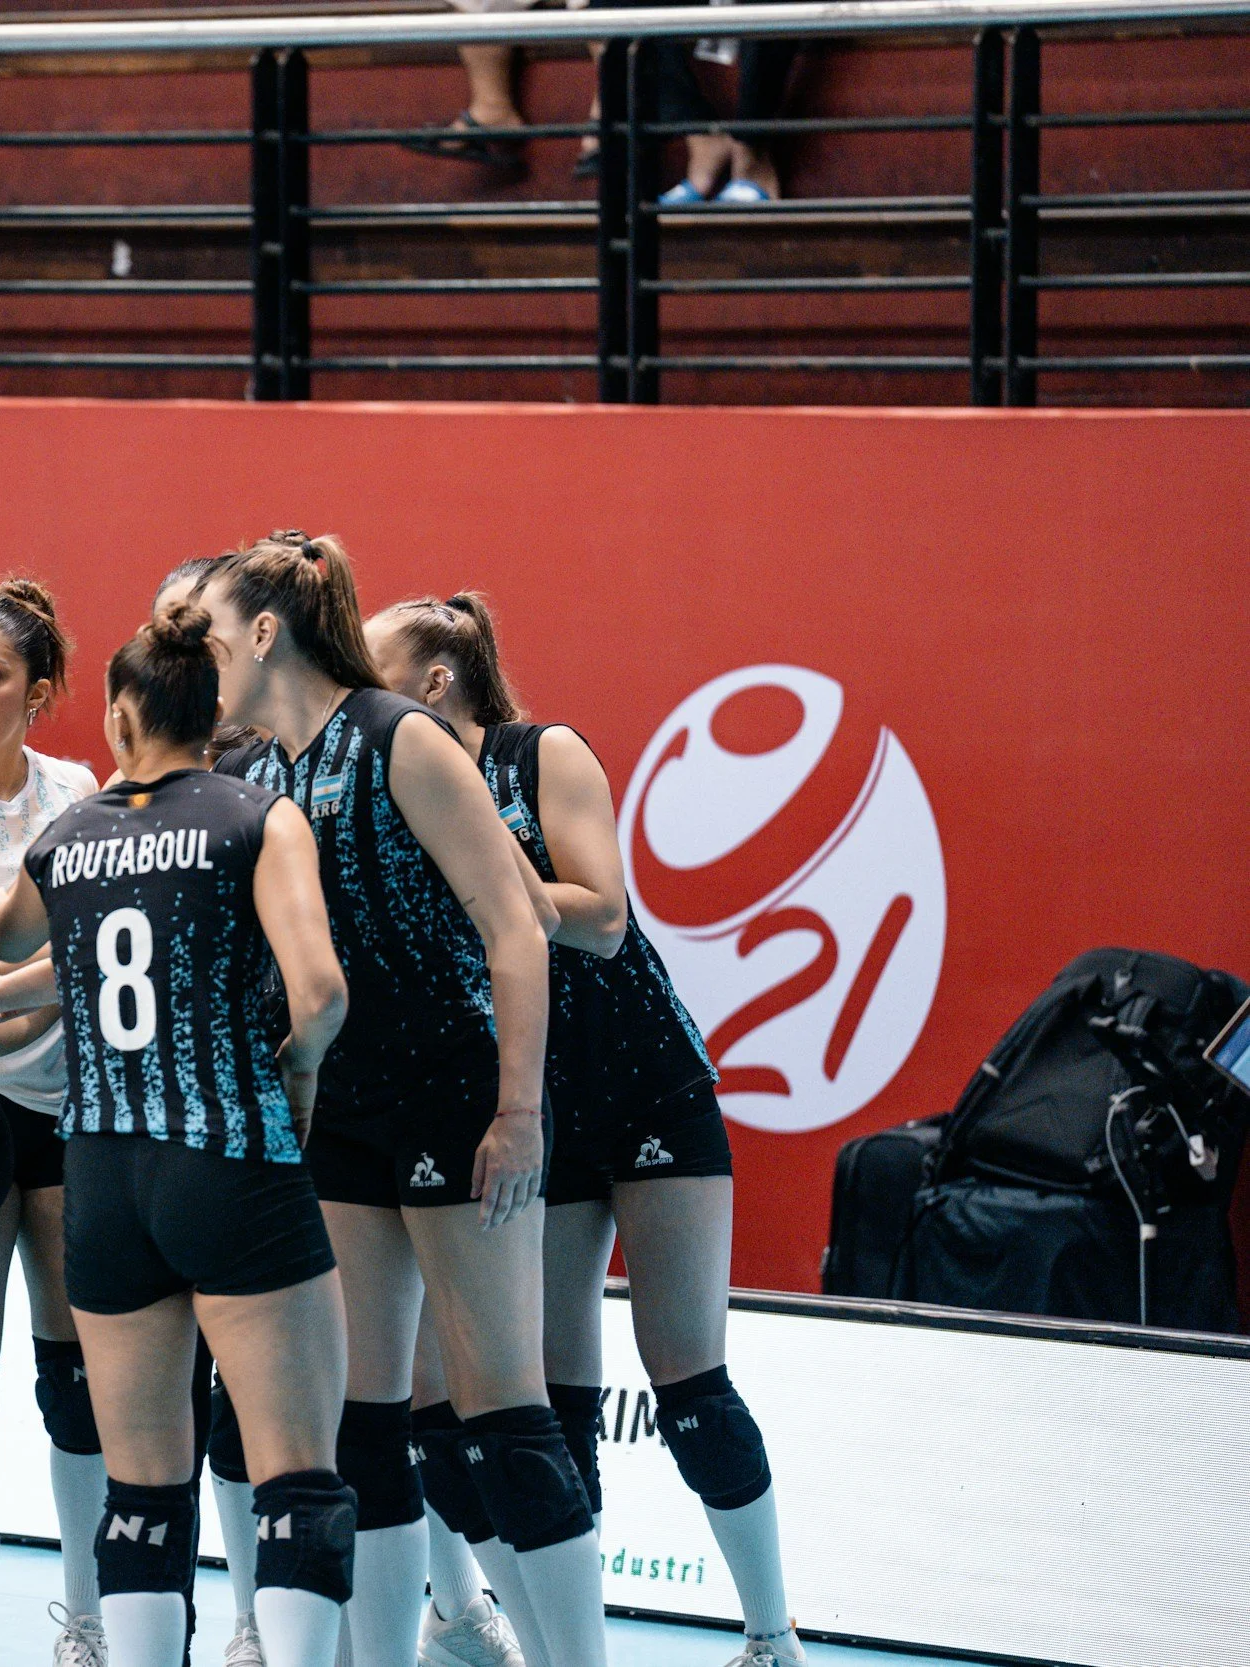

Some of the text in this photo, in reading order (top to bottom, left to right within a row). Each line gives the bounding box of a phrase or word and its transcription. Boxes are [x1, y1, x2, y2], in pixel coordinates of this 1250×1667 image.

[311, 803, 340, 819] ARG
[52, 828, 214, 888] ROUTABOUL
[96, 906, 158, 1052] 8
[676, 1414, 700, 1433] N1
[106, 1513, 167, 1547] N1
